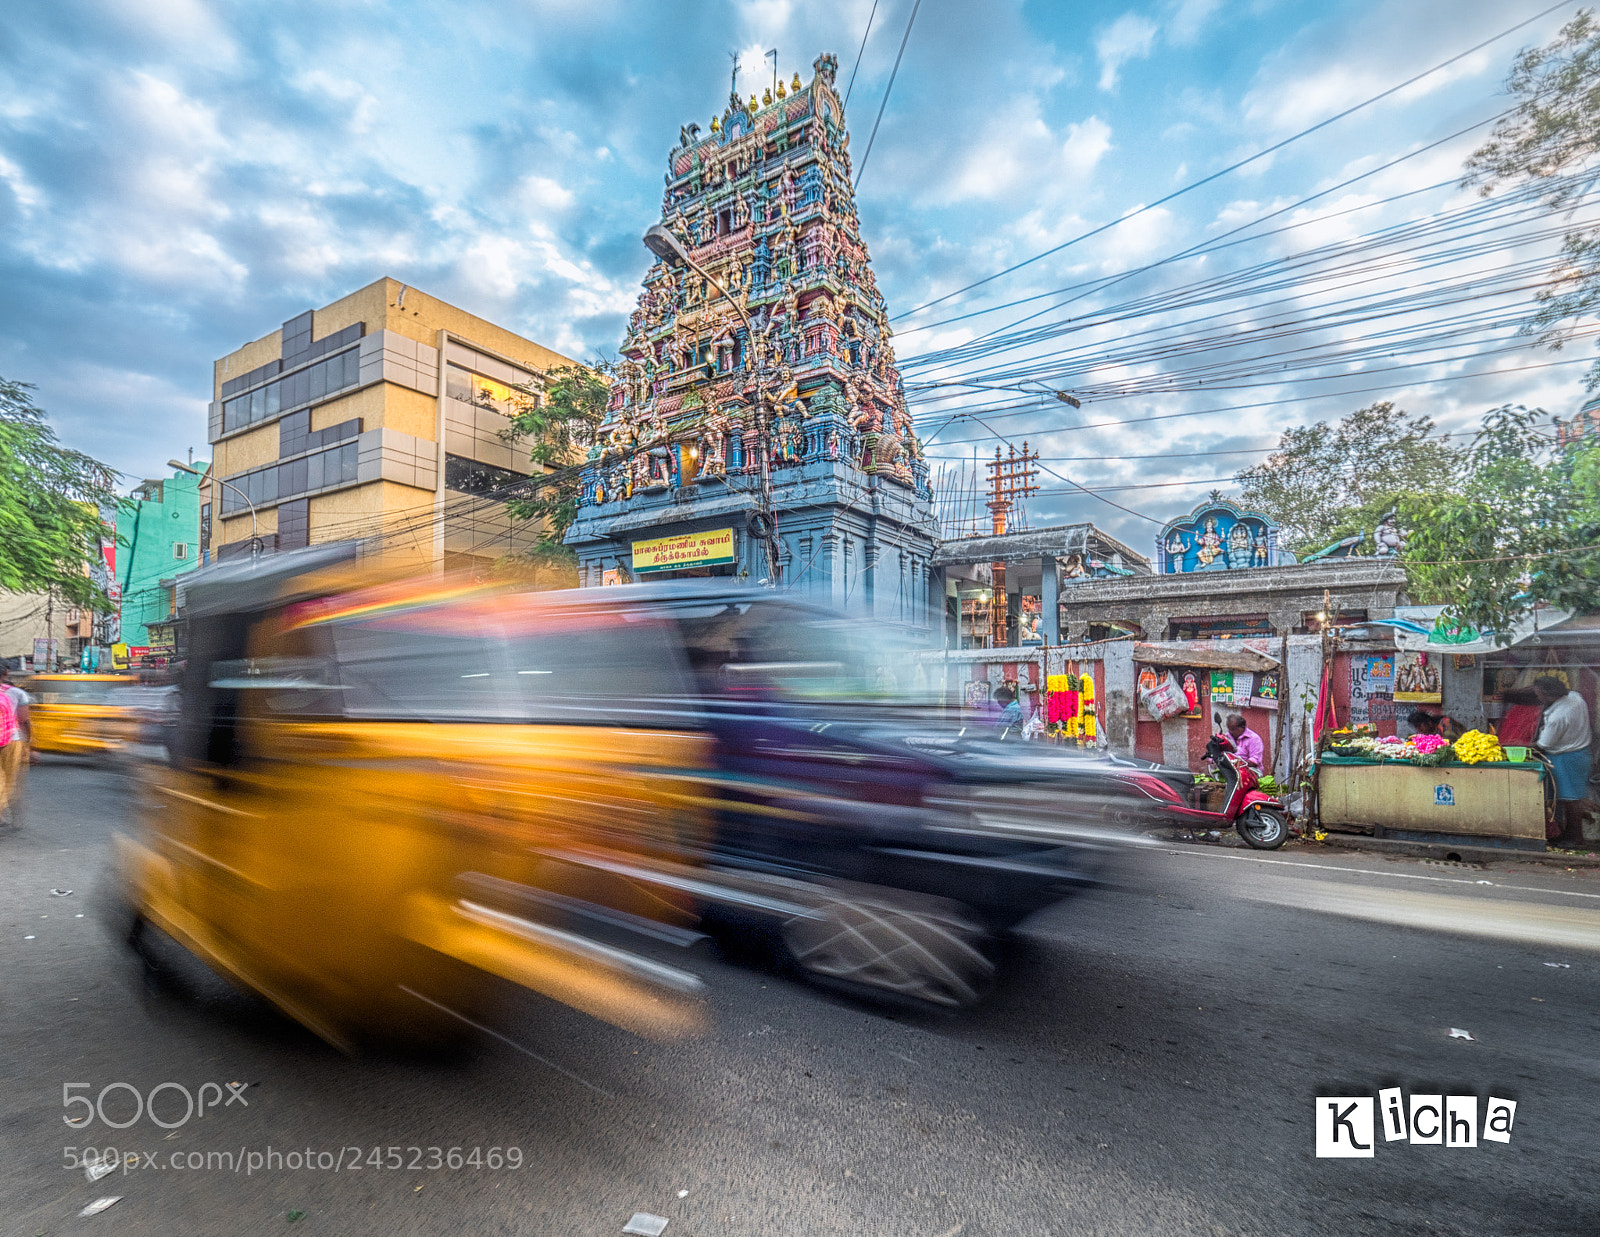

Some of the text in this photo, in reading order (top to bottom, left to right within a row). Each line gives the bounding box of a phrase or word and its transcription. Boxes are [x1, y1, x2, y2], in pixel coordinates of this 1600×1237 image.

[634, 533, 730, 555] பாலசுப்ரமணிய சுவாமி
[653, 547, 709, 563] திருக்கோயில்
